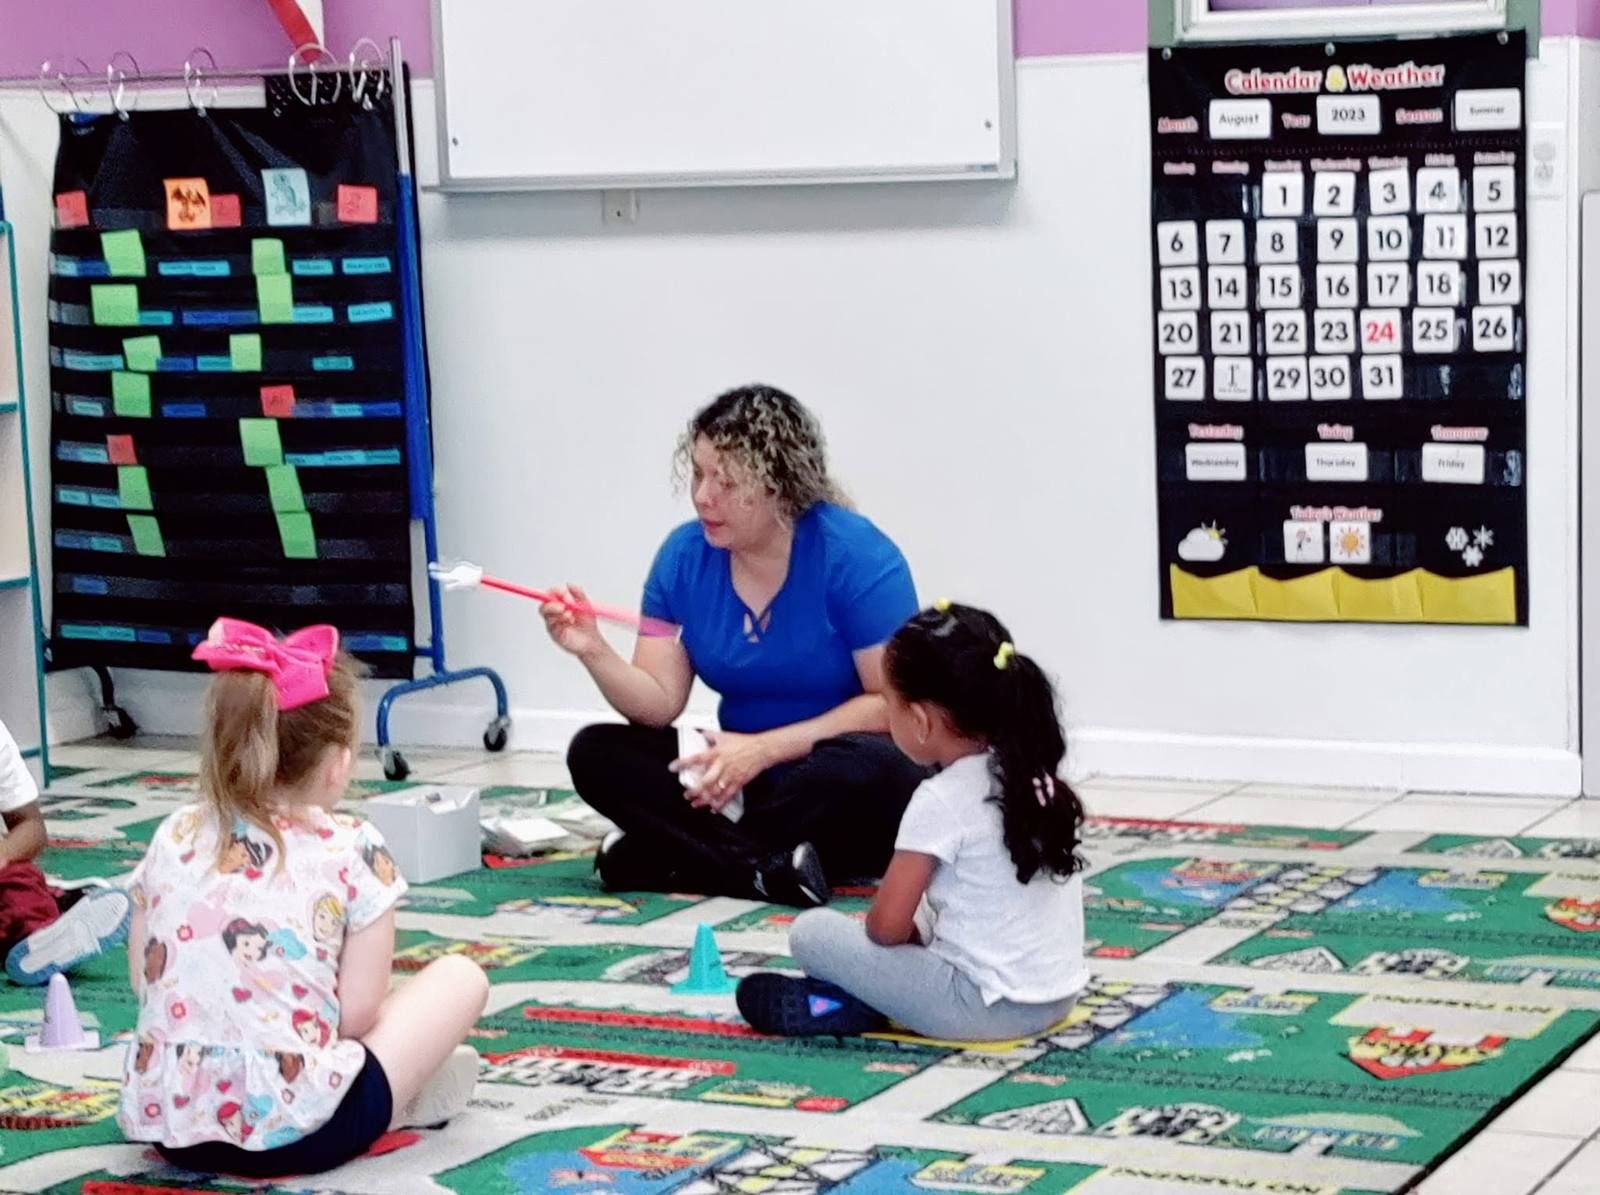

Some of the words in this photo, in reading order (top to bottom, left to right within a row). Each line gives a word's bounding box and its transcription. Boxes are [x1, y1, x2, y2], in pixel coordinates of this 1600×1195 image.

[1225, 69, 1322, 94] Calendar
[1347, 61, 1446, 92] Weather
[1219, 113, 1259, 127] August
[1331, 107, 1366, 122] 2023
[1279, 185, 1288, 208] 1
[1326, 184, 1342, 208] 2
[1382, 181, 1397, 205] 3
[1428, 180, 1447, 201] 4
[1487, 179, 1502, 203] 5
[1170, 231, 1184, 254] 6
[1219, 233, 1232, 256] 7
[1270, 231, 1285, 254] 8
[1329, 228, 1345, 251] 9
[1375, 228, 1403, 252] 10
[1436, 226, 1455, 249] 11
[1483, 225, 1510, 249] 12
[1168, 278, 1194, 301] 13
[1214, 277, 1240, 299] 14
[1267, 276, 1293, 299] 15
[1324, 275, 1351, 298] 16
[1375, 273, 1400, 297] 17
[1425, 272, 1452, 296] 18
[1487, 271, 1513, 295] 19
[1163, 321, 1193, 345] 20
[1218, 322, 1242, 345] 21
[1272, 321, 1299, 344] 22
[1320, 320, 1349, 343] 23
[1366, 321, 1394, 344] 24
[1418, 319, 1449, 342] 25
[1478, 316, 1507, 340] 26
[1171, 367, 1197, 389] 27
[1272, 367, 1302, 390] 29
[1314, 366, 1345, 388] 30
[1369, 365, 1394, 388] 31
[1438, 458, 1465, 469] Friday
